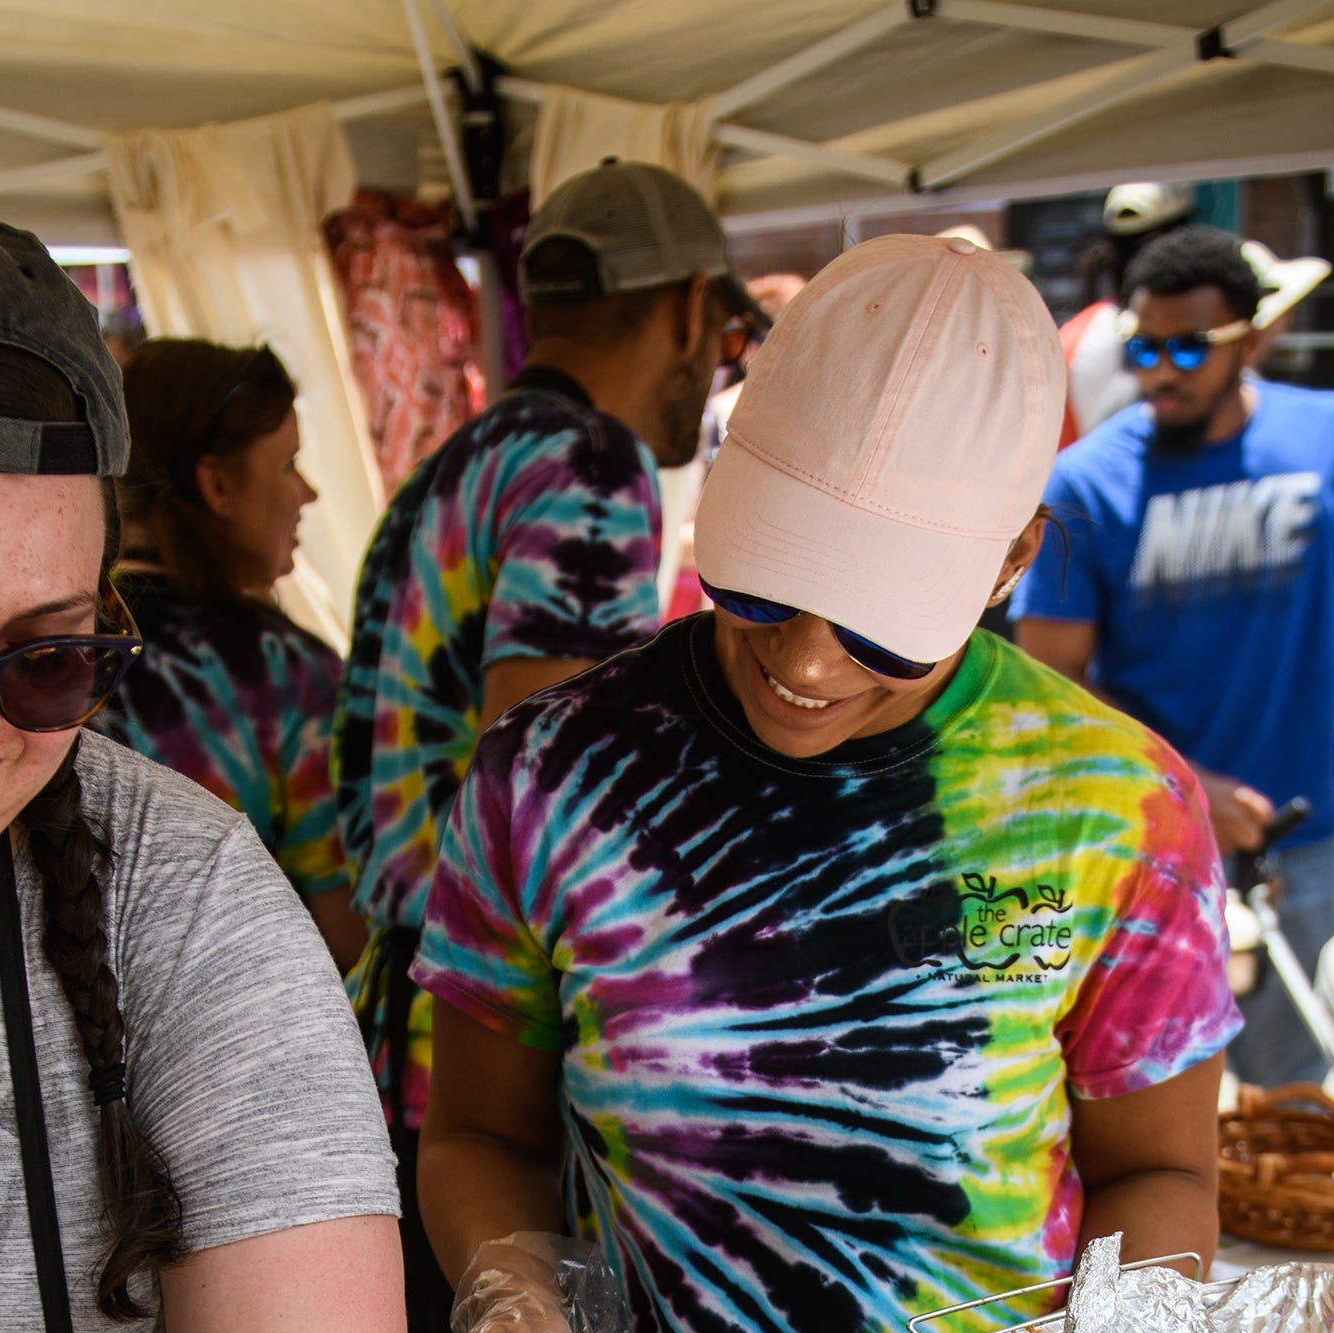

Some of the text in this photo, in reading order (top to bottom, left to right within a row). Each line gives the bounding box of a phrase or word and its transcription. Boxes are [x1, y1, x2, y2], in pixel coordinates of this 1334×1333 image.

[1130, 472, 1322, 588] NIKE
[977, 903, 1007, 923] the
[999, 919, 1072, 949] crate
[994, 972, 1049, 984] MARKET
